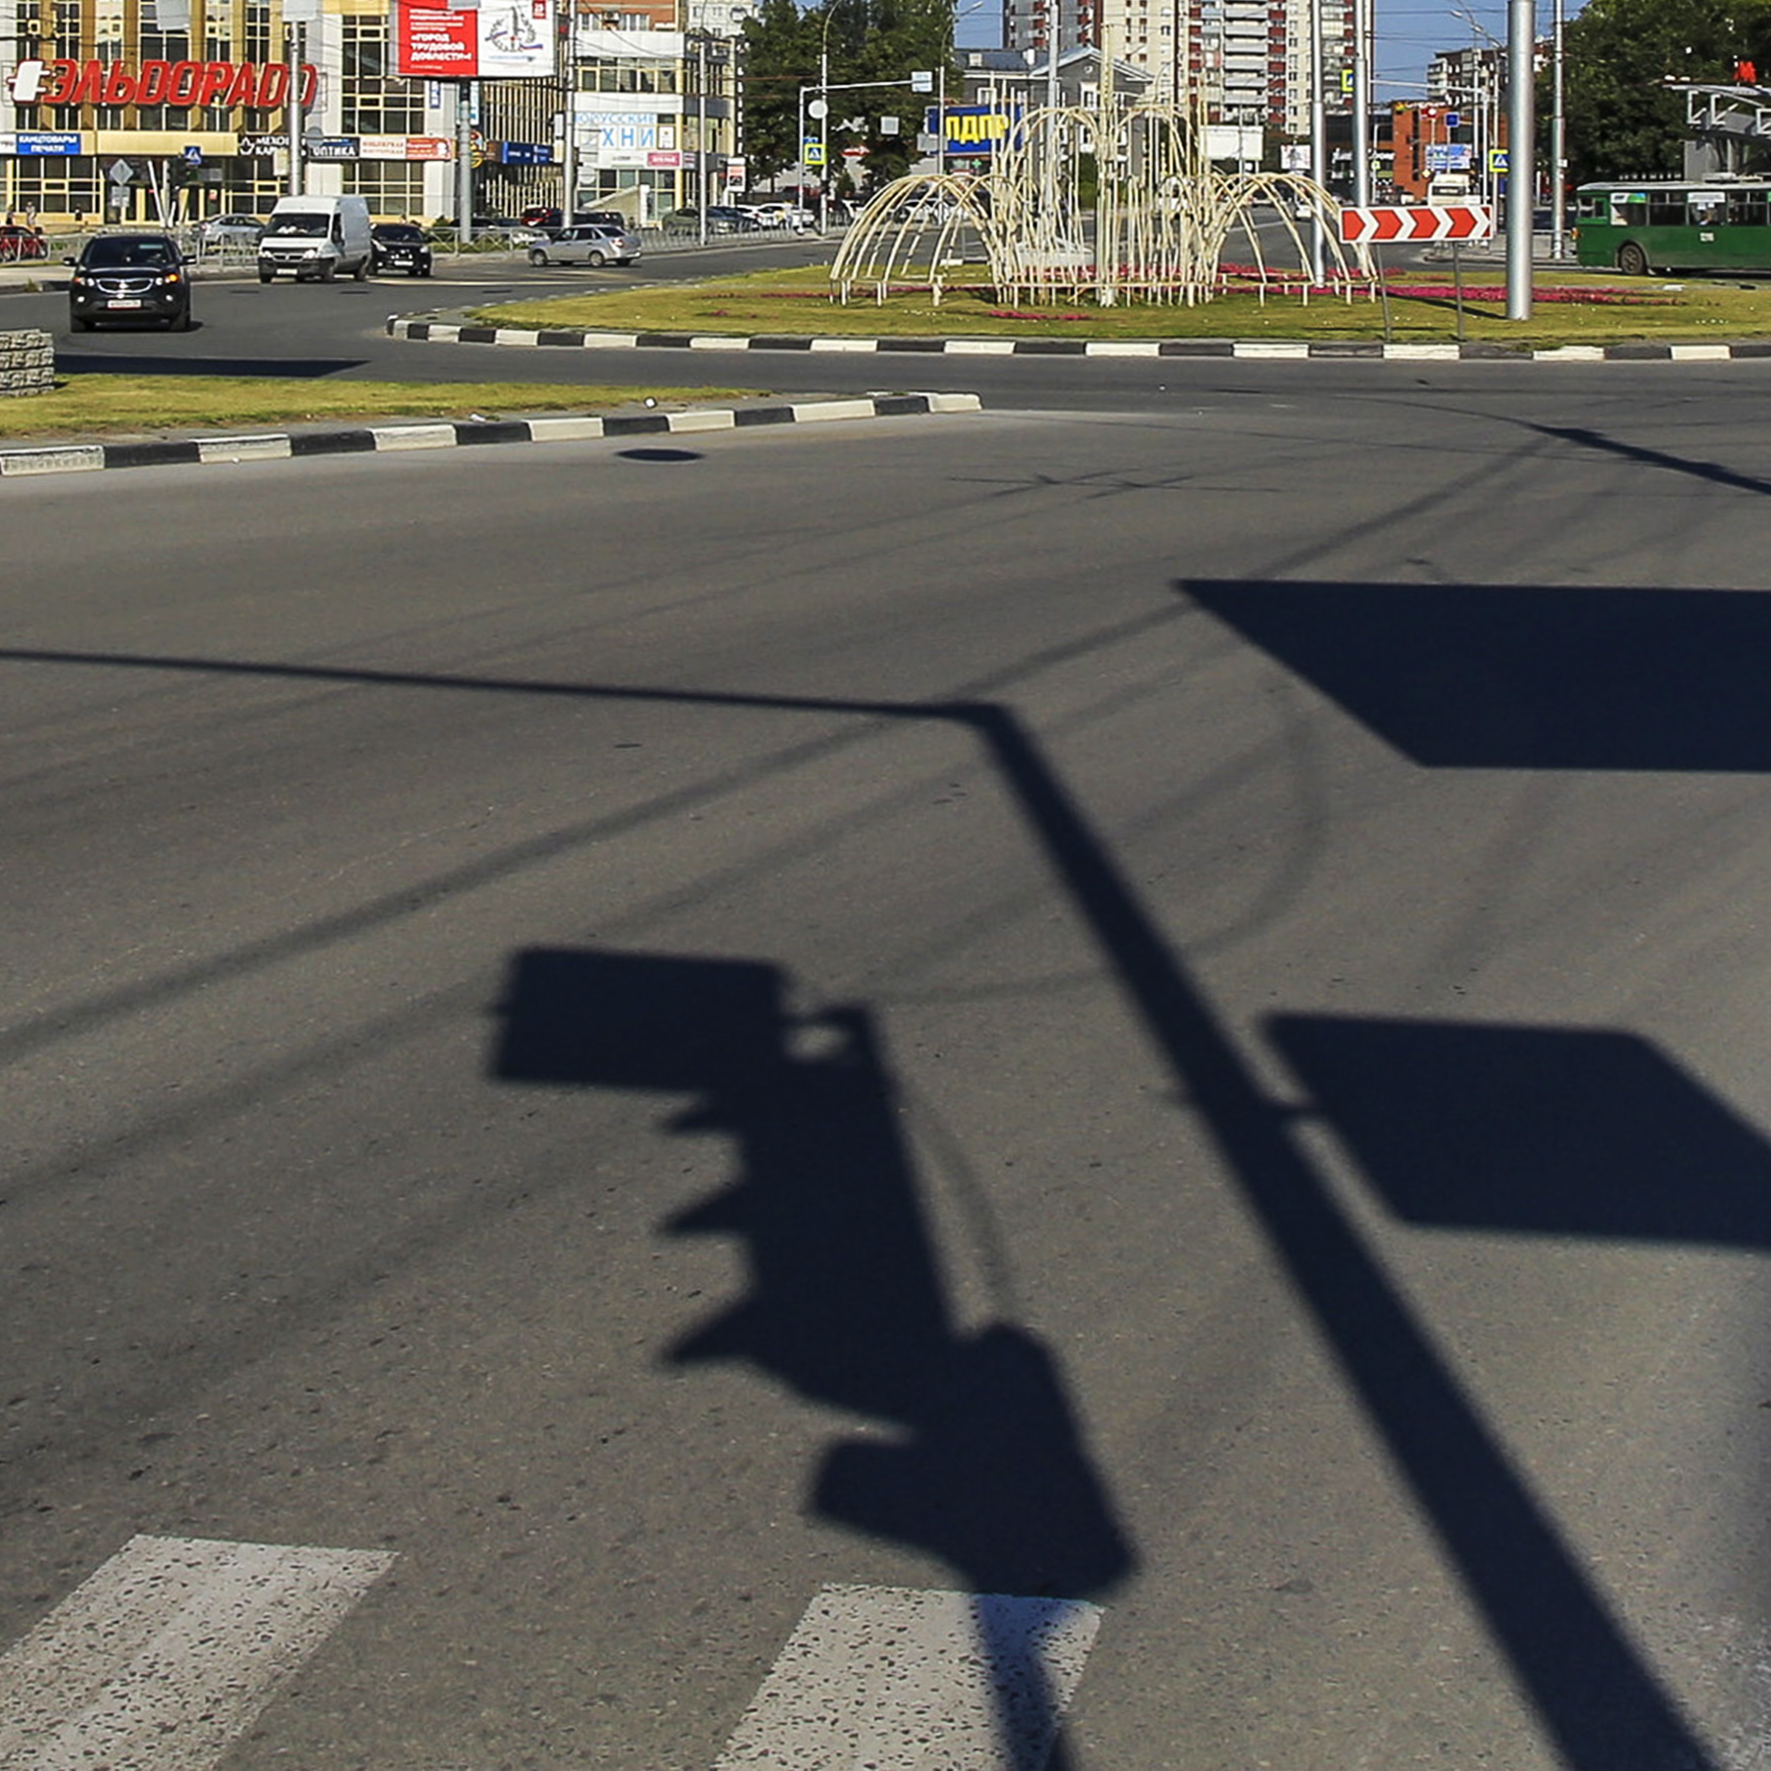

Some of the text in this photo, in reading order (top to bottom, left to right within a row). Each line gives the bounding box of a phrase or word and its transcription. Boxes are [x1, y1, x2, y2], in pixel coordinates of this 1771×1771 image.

[18, 135, 78, 144] КАНЦТОВАРЫ
[31, 144, 65, 153] ПЕЧАТИ
[313, 145, 356, 156] ОПТИКА
